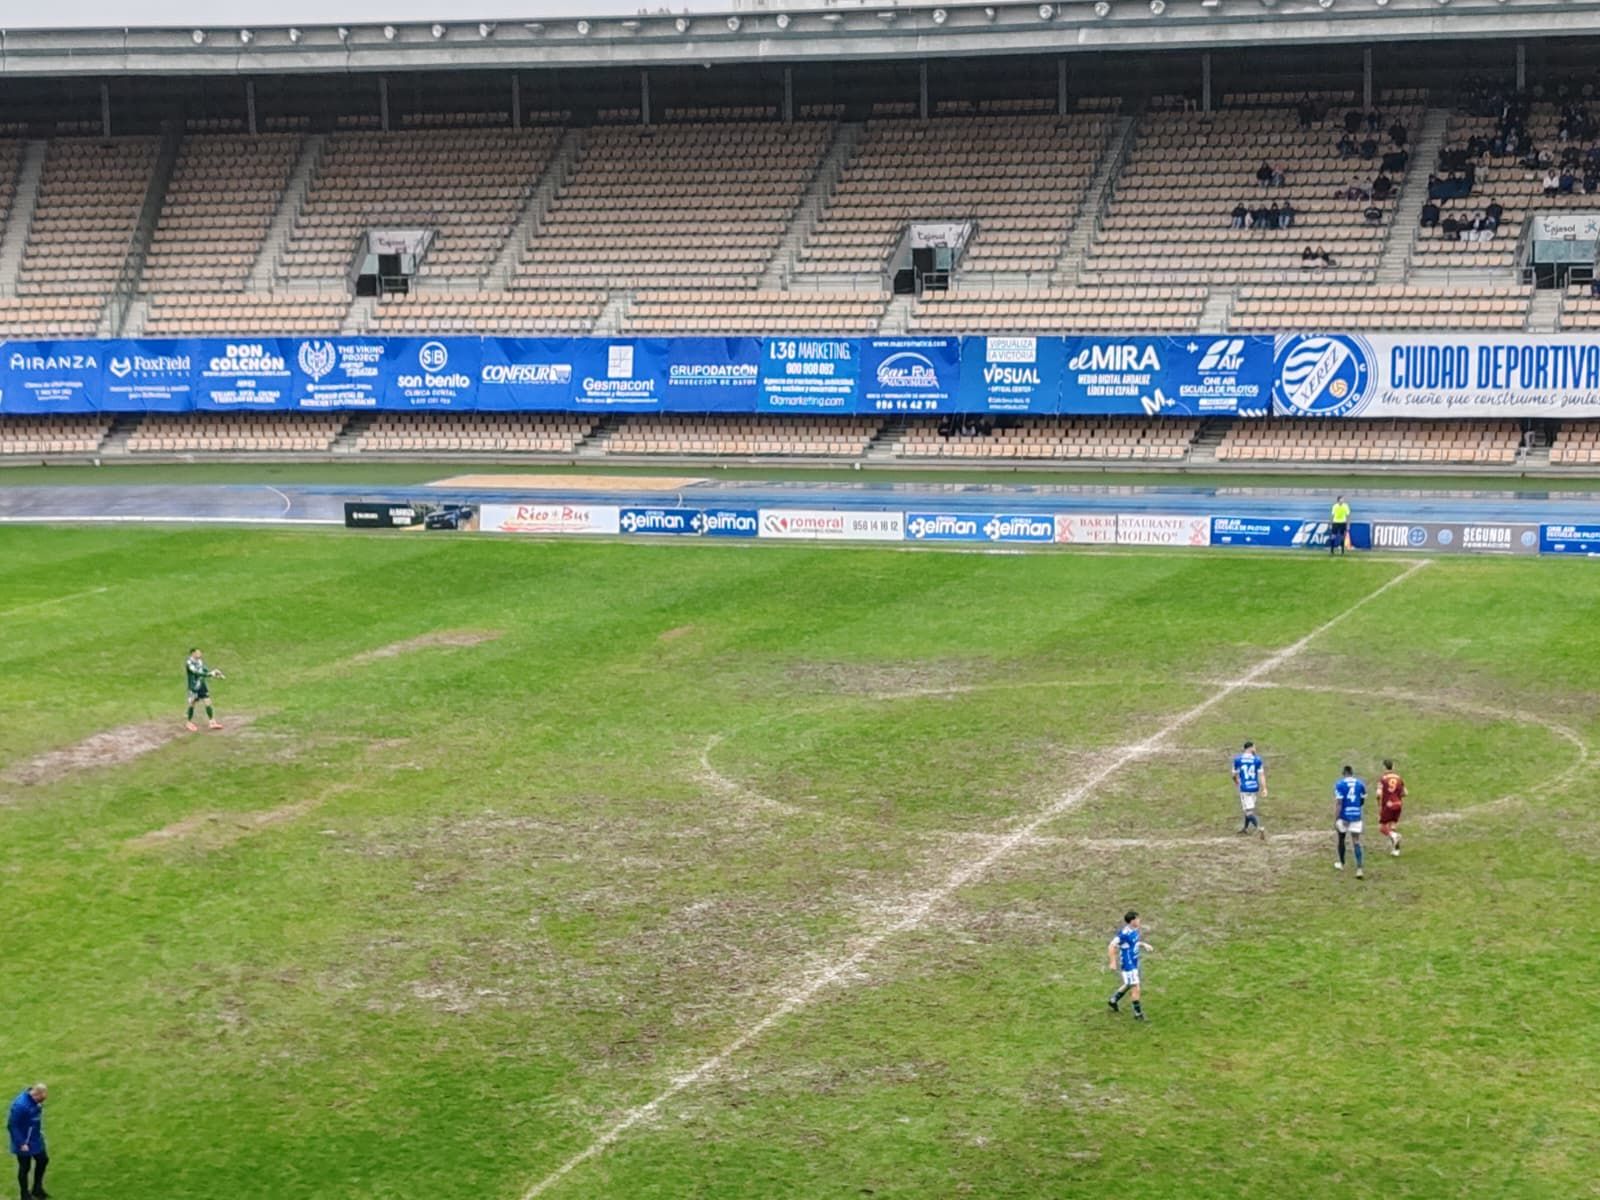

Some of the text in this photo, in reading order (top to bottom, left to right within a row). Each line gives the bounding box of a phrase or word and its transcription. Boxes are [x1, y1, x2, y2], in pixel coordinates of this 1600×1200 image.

[226, 344, 263, 357] DON
[342, 353, 380, 363] PROJECT
[134, 355, 191, 370] FoxField
[210, 352, 285, 371] COLCHÓN
[1391, 345, 1600, 389] CIUDAD DEPORTIVA
[397, 372, 470, 388] san benito
[583, 377, 654, 391] Gesmacont
[562, 506, 591, 521] Bus
[790, 516, 844, 529] romeral
[1463, 526, 1512, 542] SEGUNDA
[1240, 764, 1256, 779] 14
[1346, 785, 1356, 802] 4
